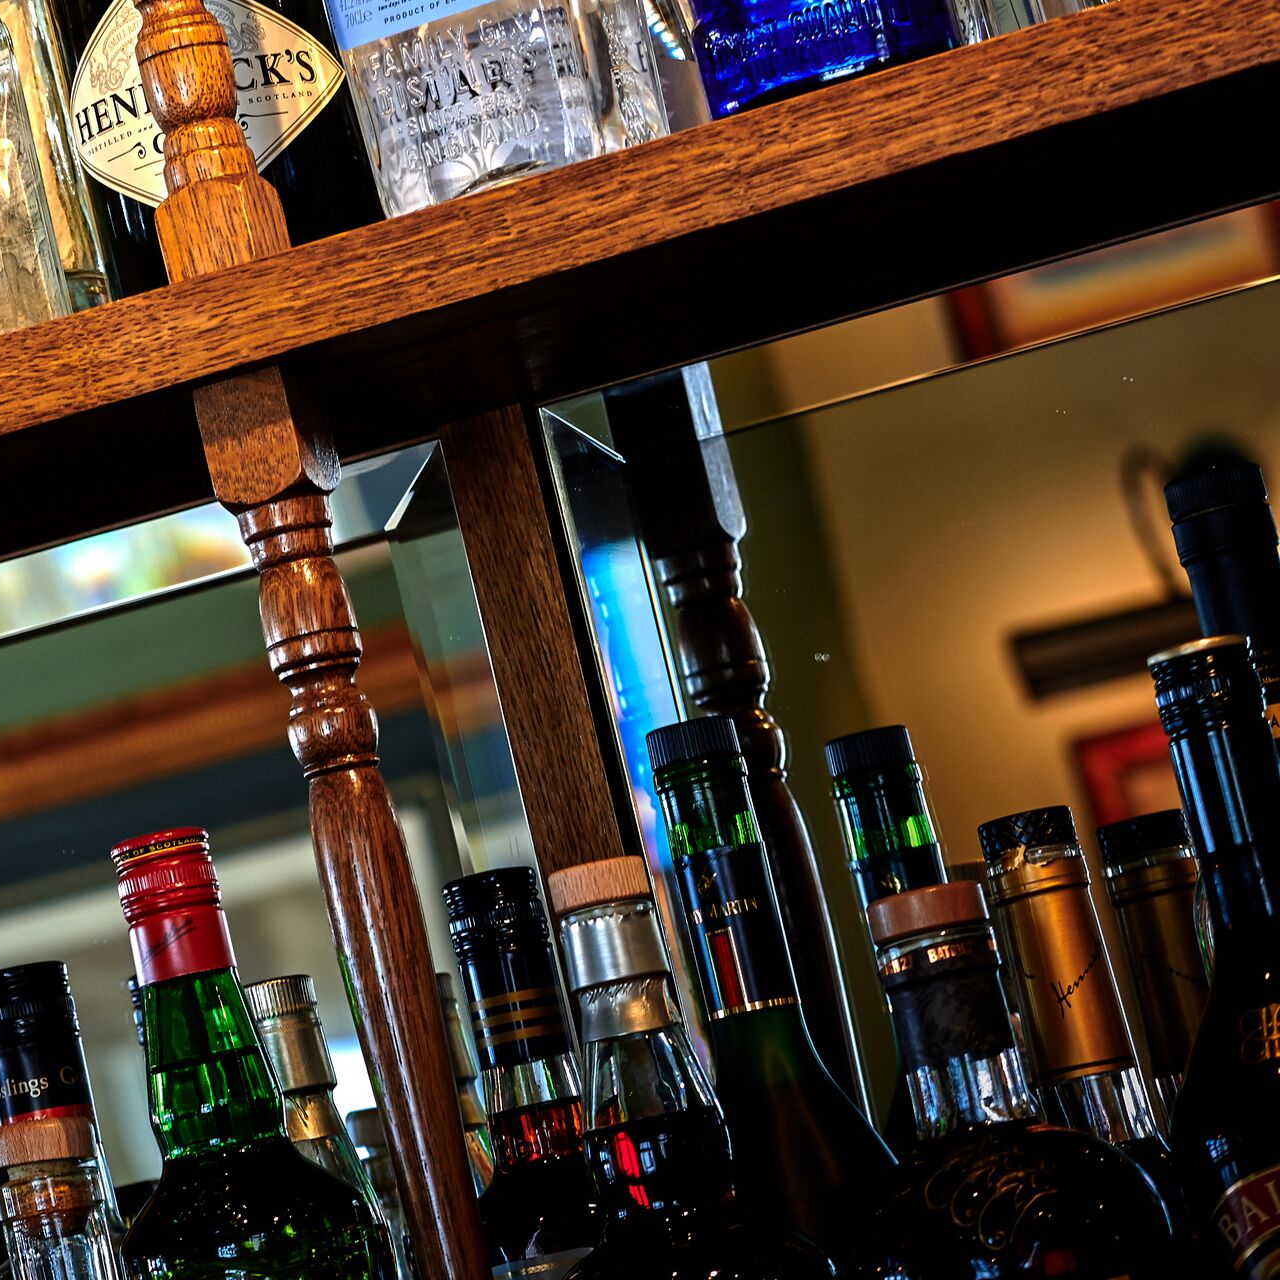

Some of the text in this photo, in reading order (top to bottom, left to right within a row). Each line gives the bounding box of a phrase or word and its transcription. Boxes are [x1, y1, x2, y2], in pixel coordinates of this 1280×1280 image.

[383, 7, 425, 25] PRODUCT
[429, 0, 441, 9] OF
[366, 23, 467, 83] FAMILY
[87, 129, 133, 157] DISTILLED
[133, 848, 145, 857] OF
